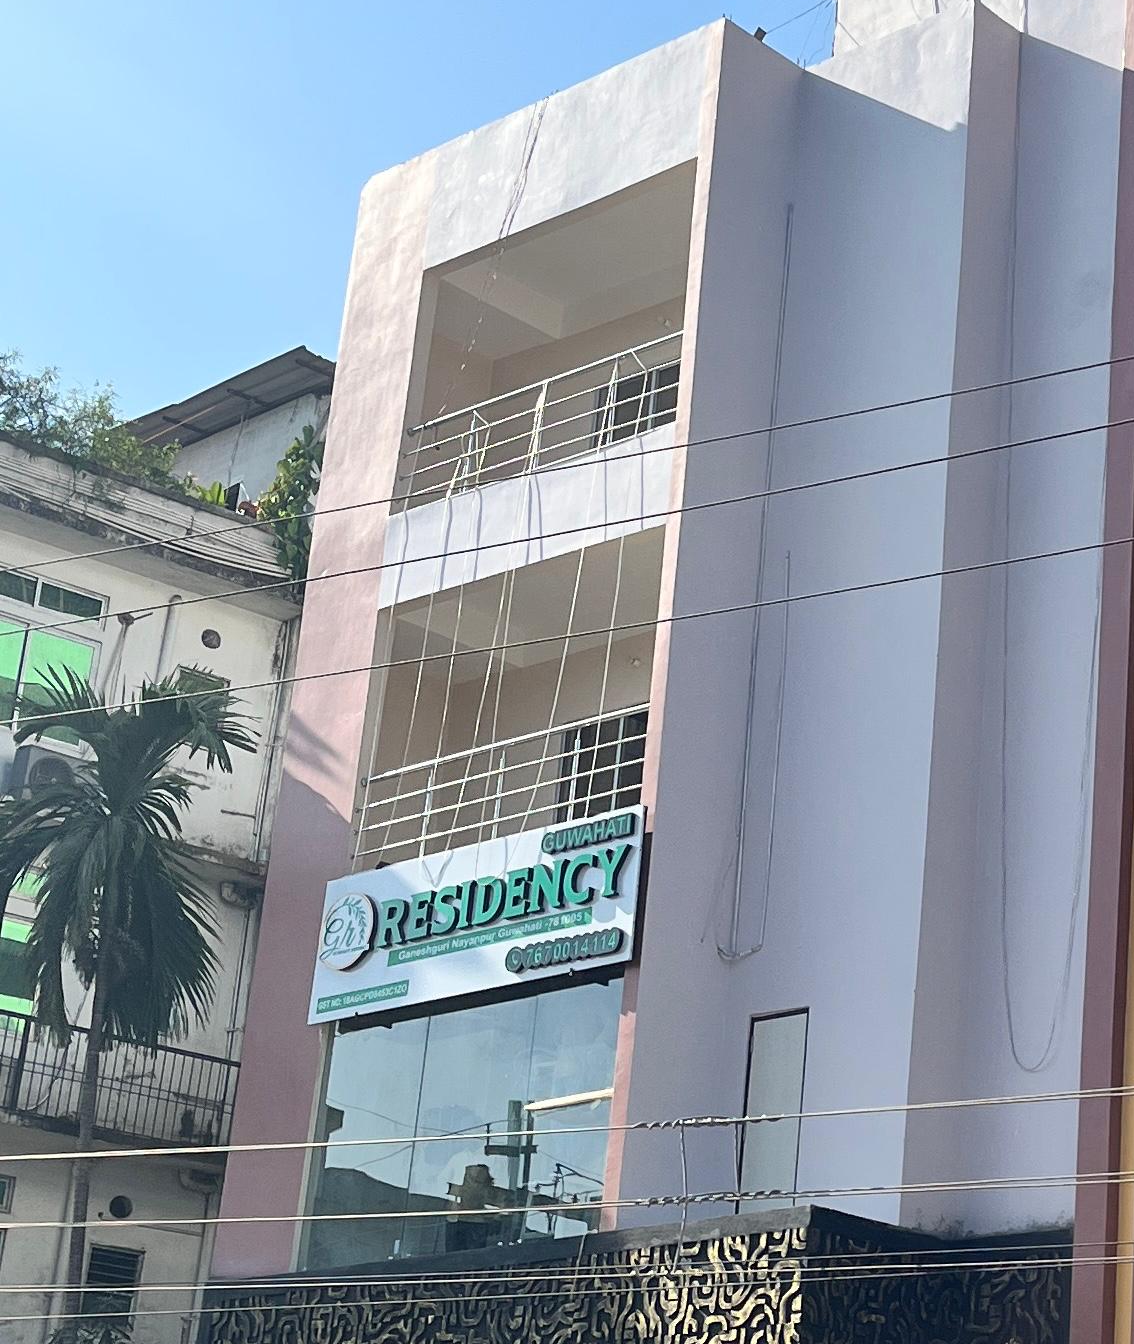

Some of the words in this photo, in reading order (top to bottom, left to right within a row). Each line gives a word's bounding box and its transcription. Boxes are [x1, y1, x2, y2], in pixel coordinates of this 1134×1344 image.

[544, 815, 632, 851] GUWAHATI
[377, 845, 630, 948] RESIDENCY
[398, 942, 450, 960] Ganeshguri
[452, 931, 496, 951] Nayanpur
[498, 921, 543, 939] Guwahati
[526, 932, 616, 966] 7670014114
